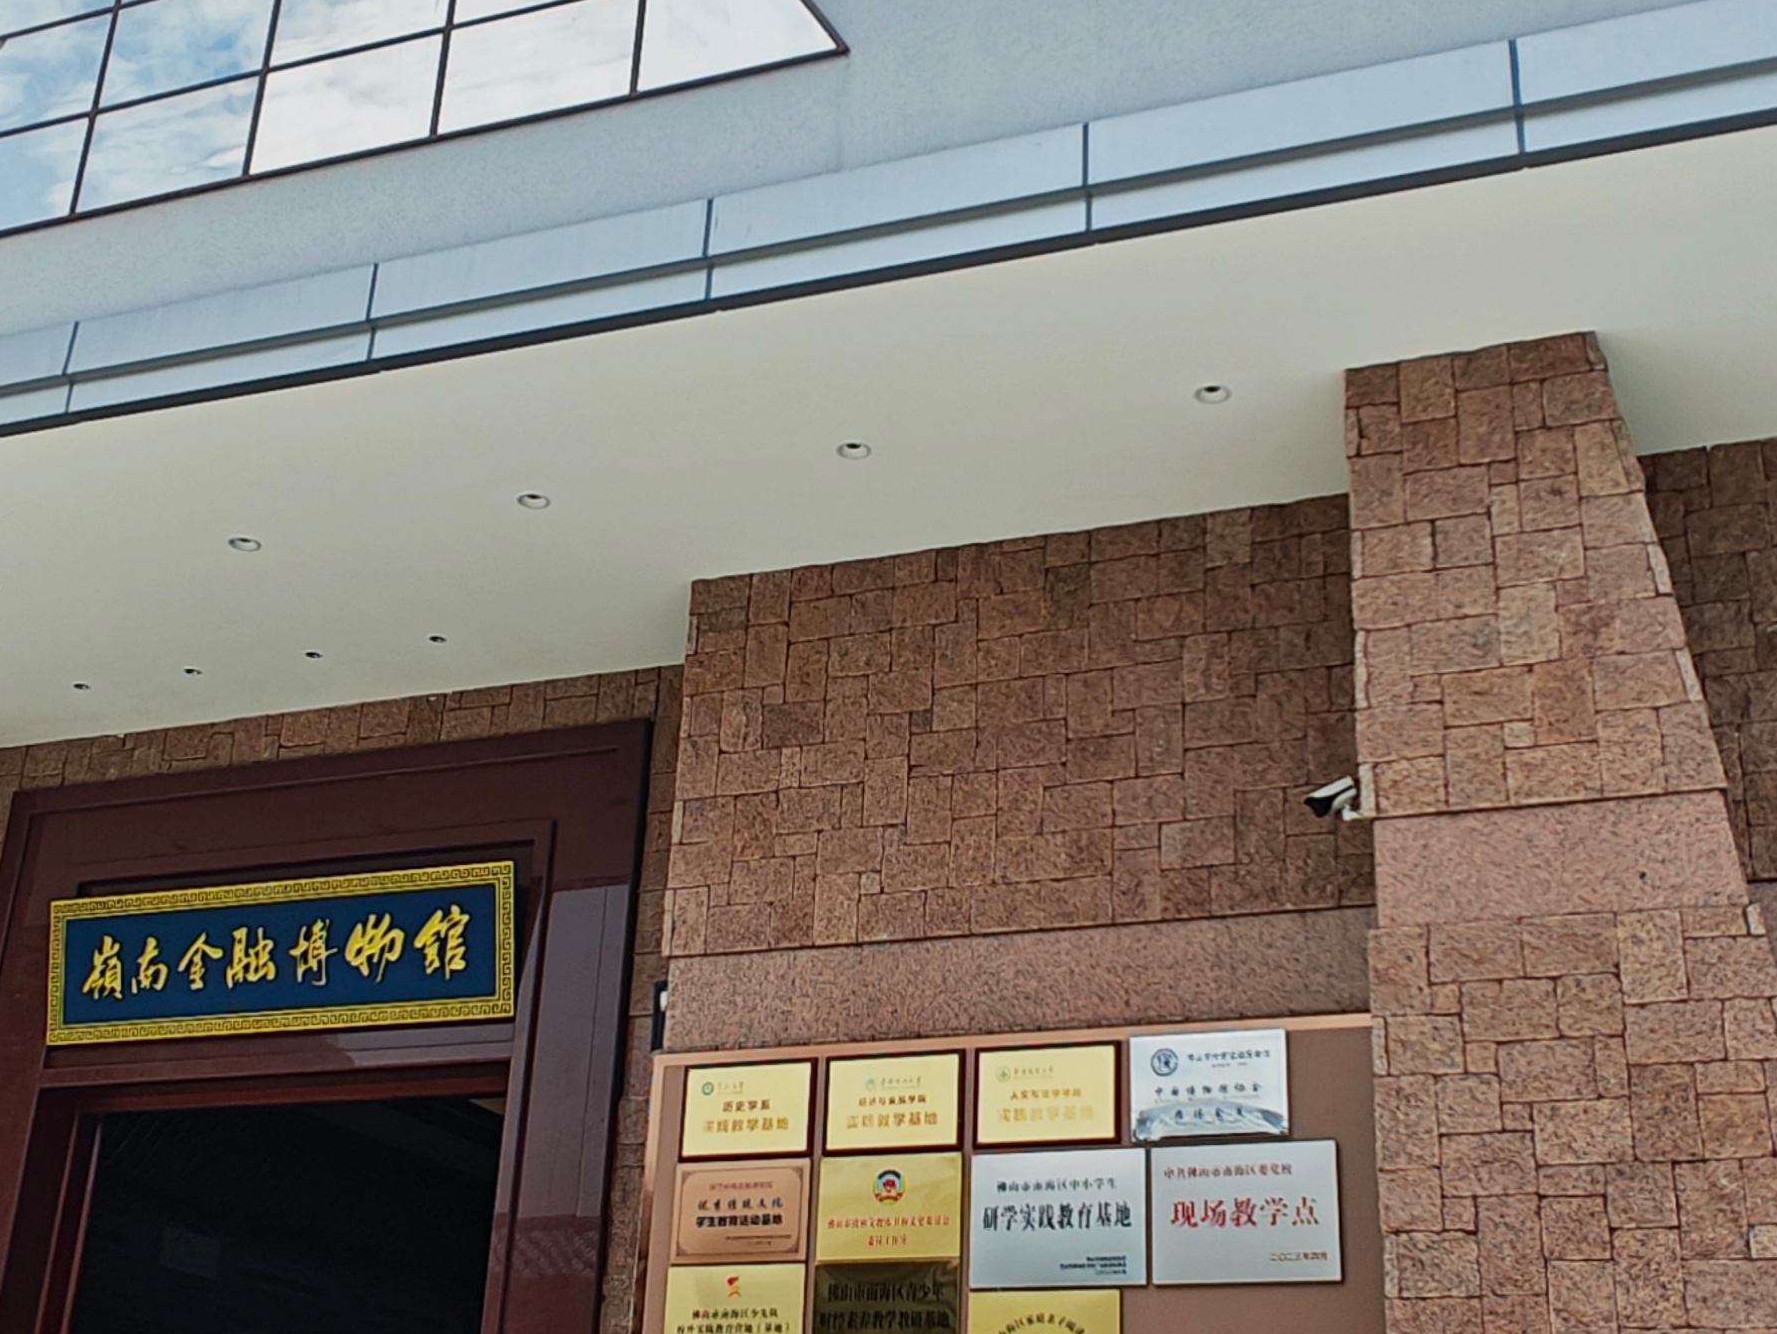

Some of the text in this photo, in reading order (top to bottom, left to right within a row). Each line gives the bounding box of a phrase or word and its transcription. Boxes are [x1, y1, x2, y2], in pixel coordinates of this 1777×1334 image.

[996, 1177, 1117, 1193] 佛山市南海区中小学生
[983, 1200, 1133, 1232] 研学实践教育基地
[1170, 1197, 1320, 1228] 现场教学点
